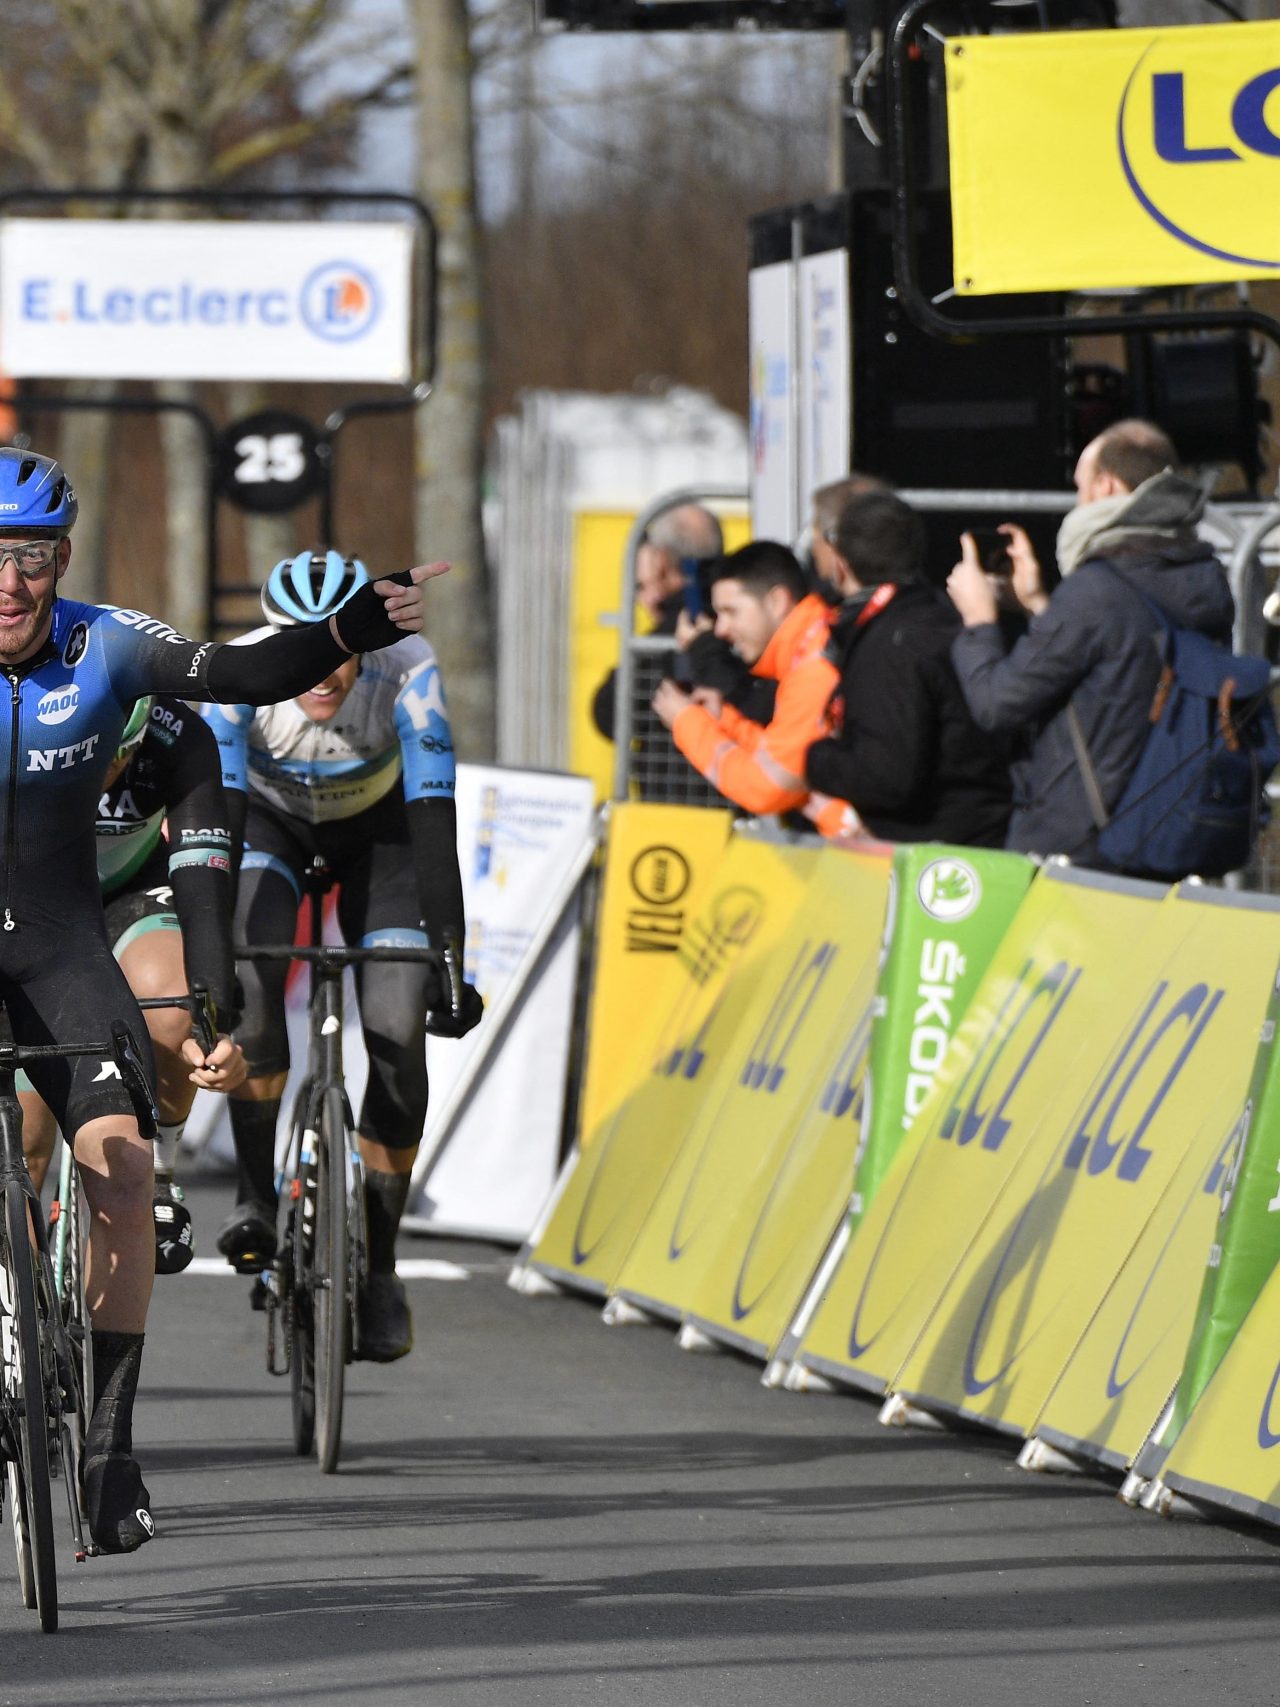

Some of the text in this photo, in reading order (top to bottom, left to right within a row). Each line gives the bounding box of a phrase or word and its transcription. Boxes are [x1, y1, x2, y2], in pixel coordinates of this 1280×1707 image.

[21, 277, 292, 325] E.Leclerc
[234, 434, 305, 484] 25
[151, 704, 184, 737] ORA
[26, 733, 100, 772] NTT
[901, 938, 967, 1131] ŠKOD
[1063, 980, 1226, 1183] LCL
